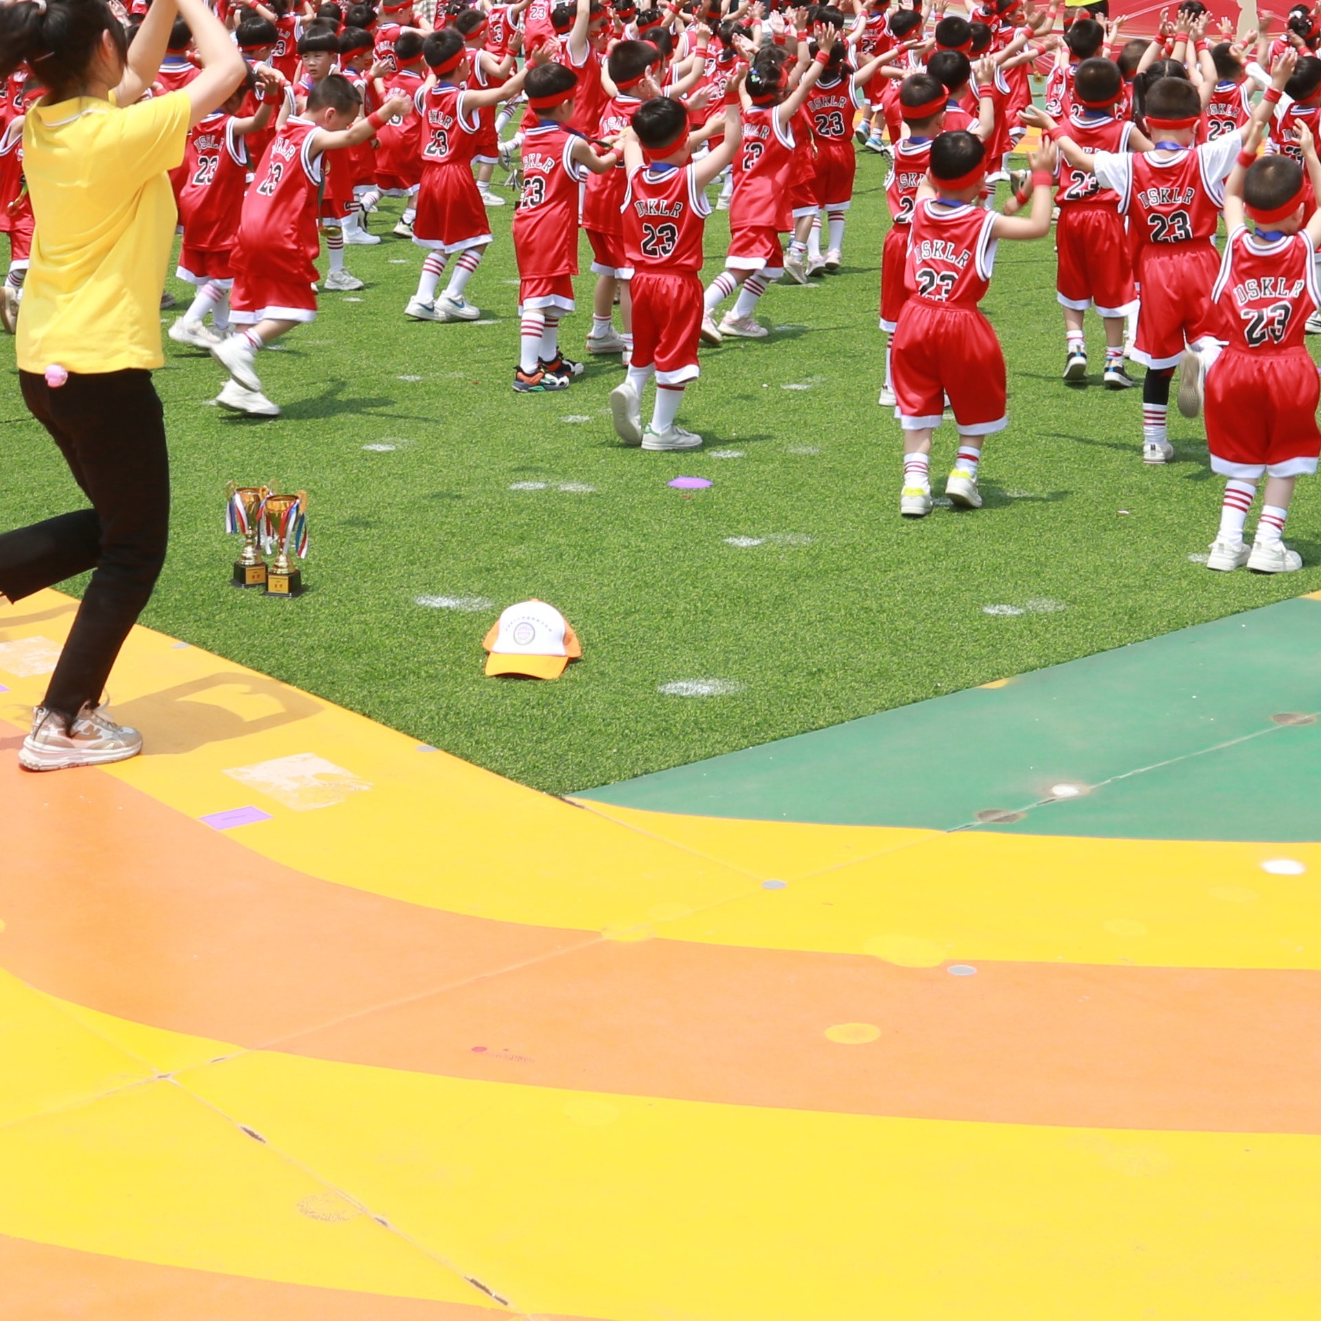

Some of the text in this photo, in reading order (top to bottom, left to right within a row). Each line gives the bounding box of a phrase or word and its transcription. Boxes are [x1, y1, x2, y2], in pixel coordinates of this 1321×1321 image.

[814, 112, 845, 137] 23
[1138, 186, 1195, 210] DSKLR
[641, 223, 678, 257] 23
[1148, 209, 1194, 243] 23
[916, 267, 960, 303] 23
[1234, 276, 1306, 307] DSKLR
[1240, 300, 1293, 348] 23
